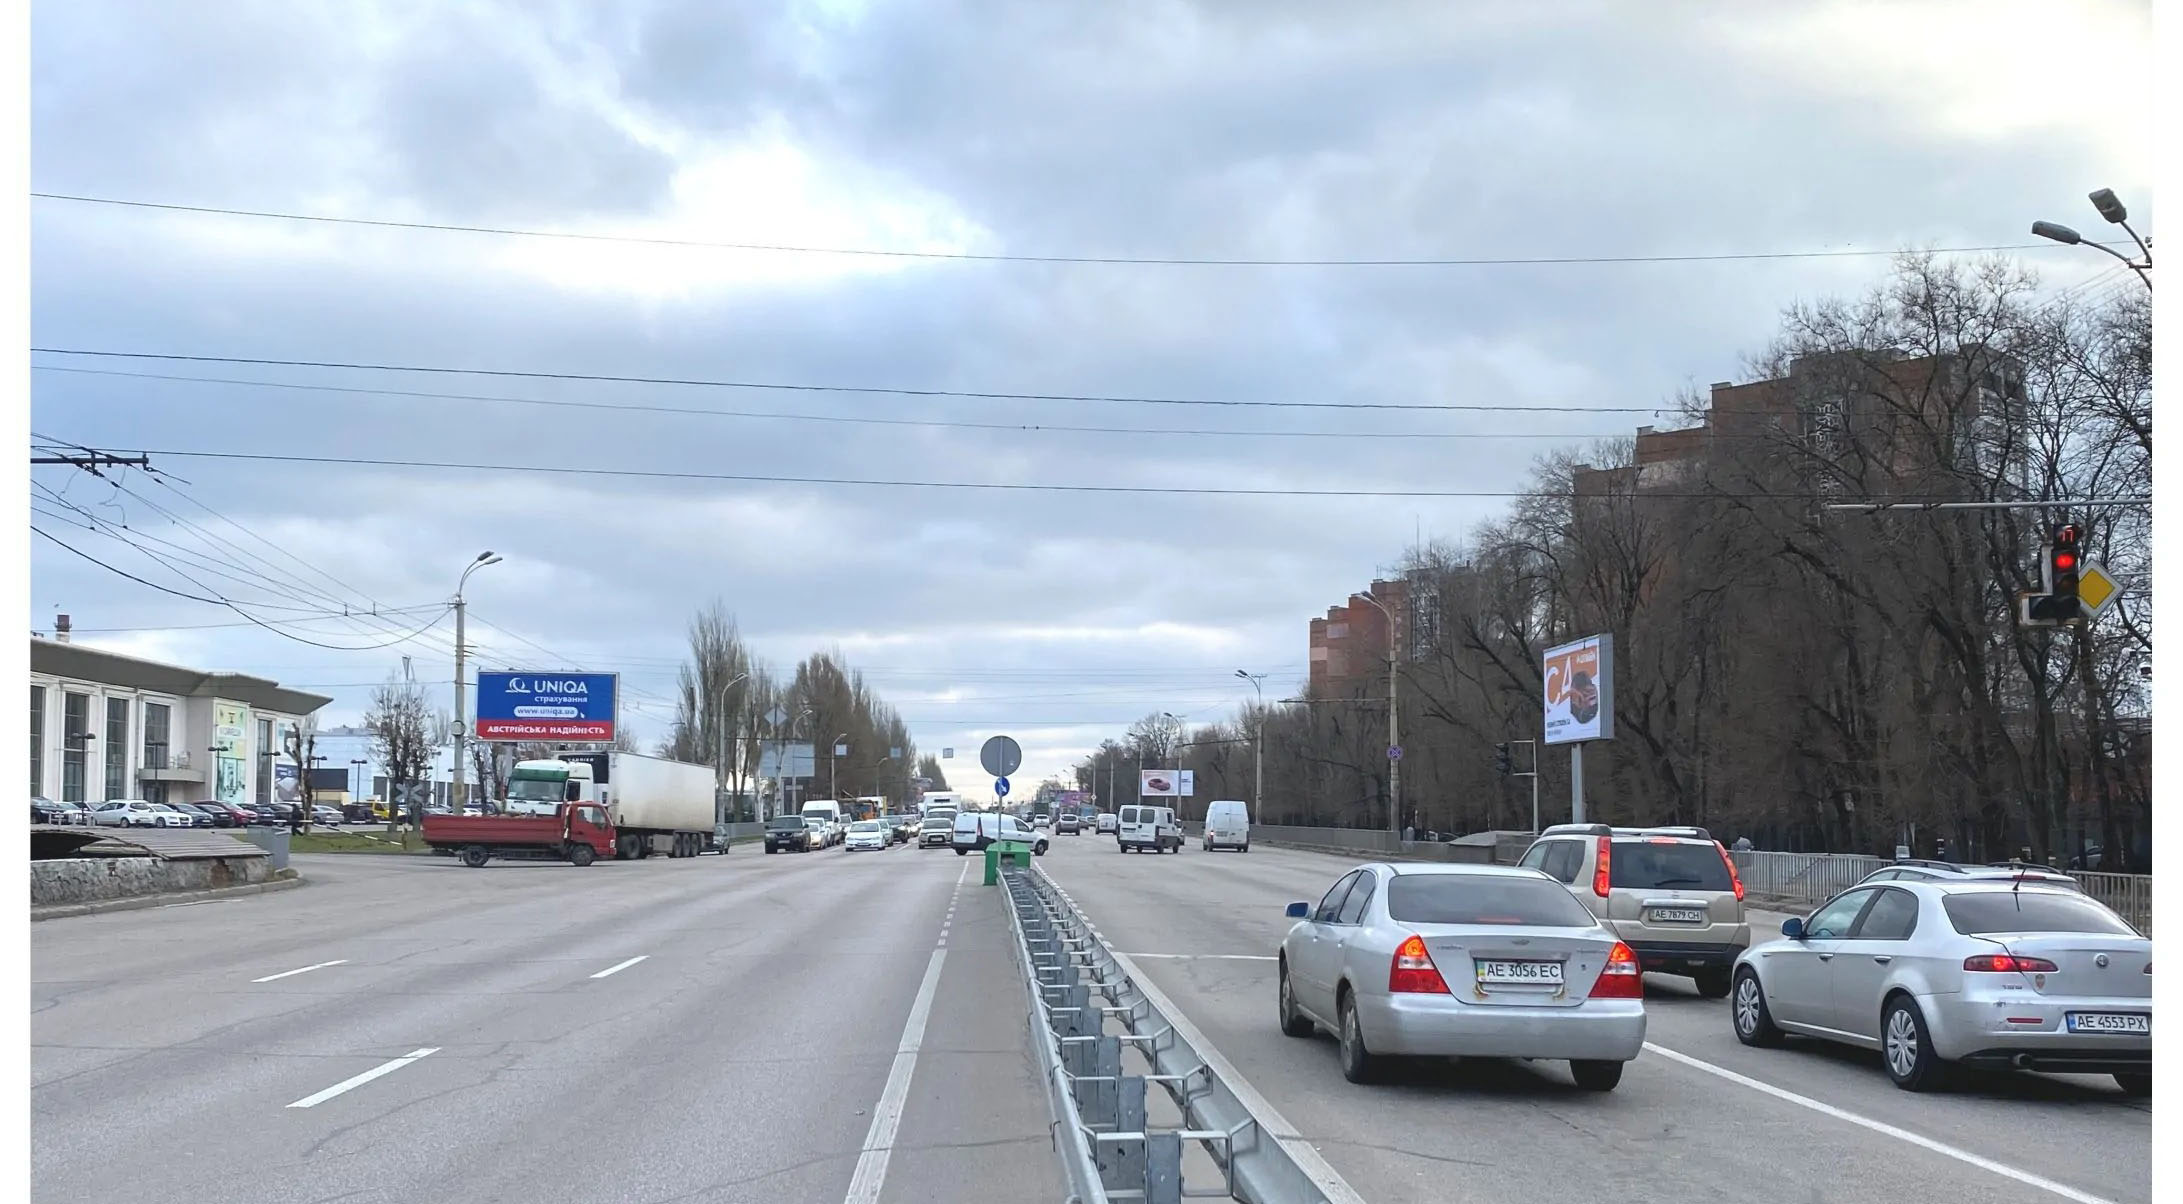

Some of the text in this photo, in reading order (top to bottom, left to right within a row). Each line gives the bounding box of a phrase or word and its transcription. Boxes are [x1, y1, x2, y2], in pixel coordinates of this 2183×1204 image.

[534, 680, 588, 693] UNIQA
[534, 695, 588, 704] страхування
[517, 708, 575, 716] www.uniqa.ua
[487, 725, 605, 735] АВСТРІЙСЬКА НАДІЙНІСТЬ
[1655, 910, 1666, 918] AE
[1687, 911, 1700, 920] CH
[1486, 964, 1560, 978] AE 3056 EC
[2078, 1015, 2146, 1030] AE 4553 PX
